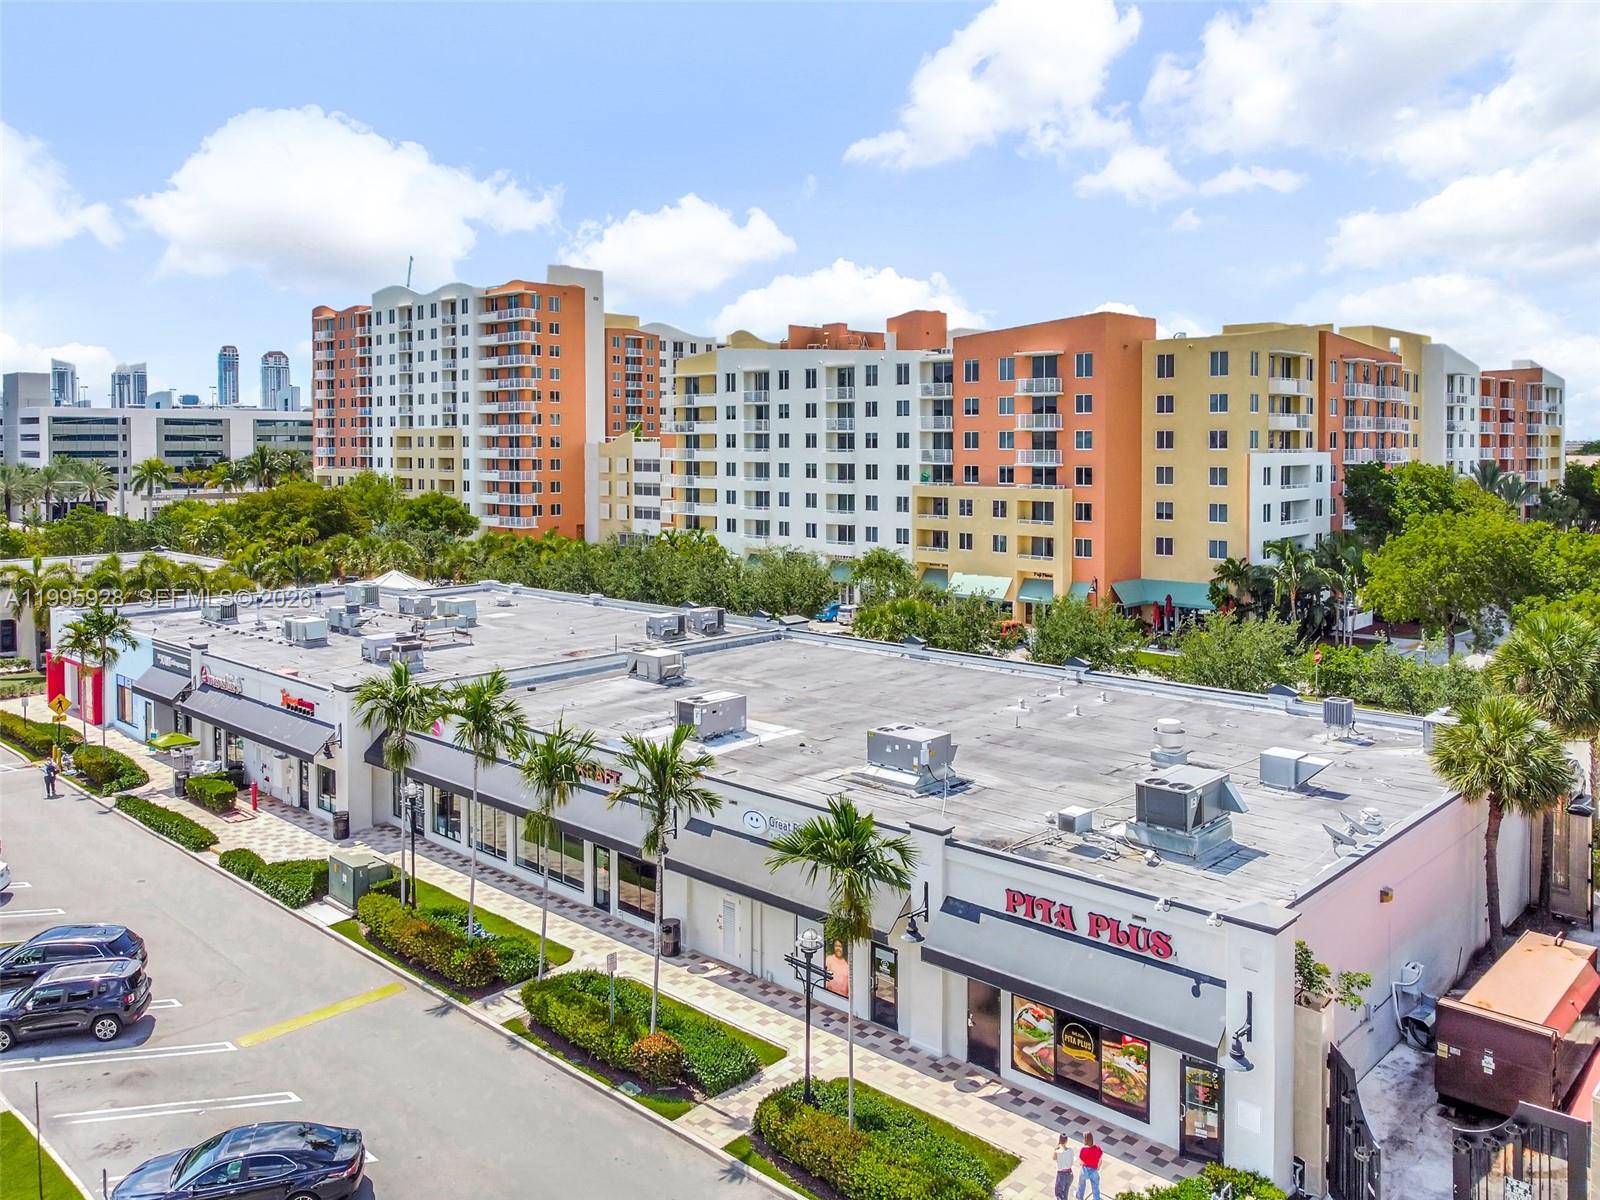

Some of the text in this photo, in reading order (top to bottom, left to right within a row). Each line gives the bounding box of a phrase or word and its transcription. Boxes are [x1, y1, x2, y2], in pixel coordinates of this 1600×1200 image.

[769, 816, 791, 832] Great
[1004, 888, 1174, 959] PITA PLUS
[1064, 1034, 1077, 1045] PITA
[1077, 1038, 1092, 1051] PLUS
